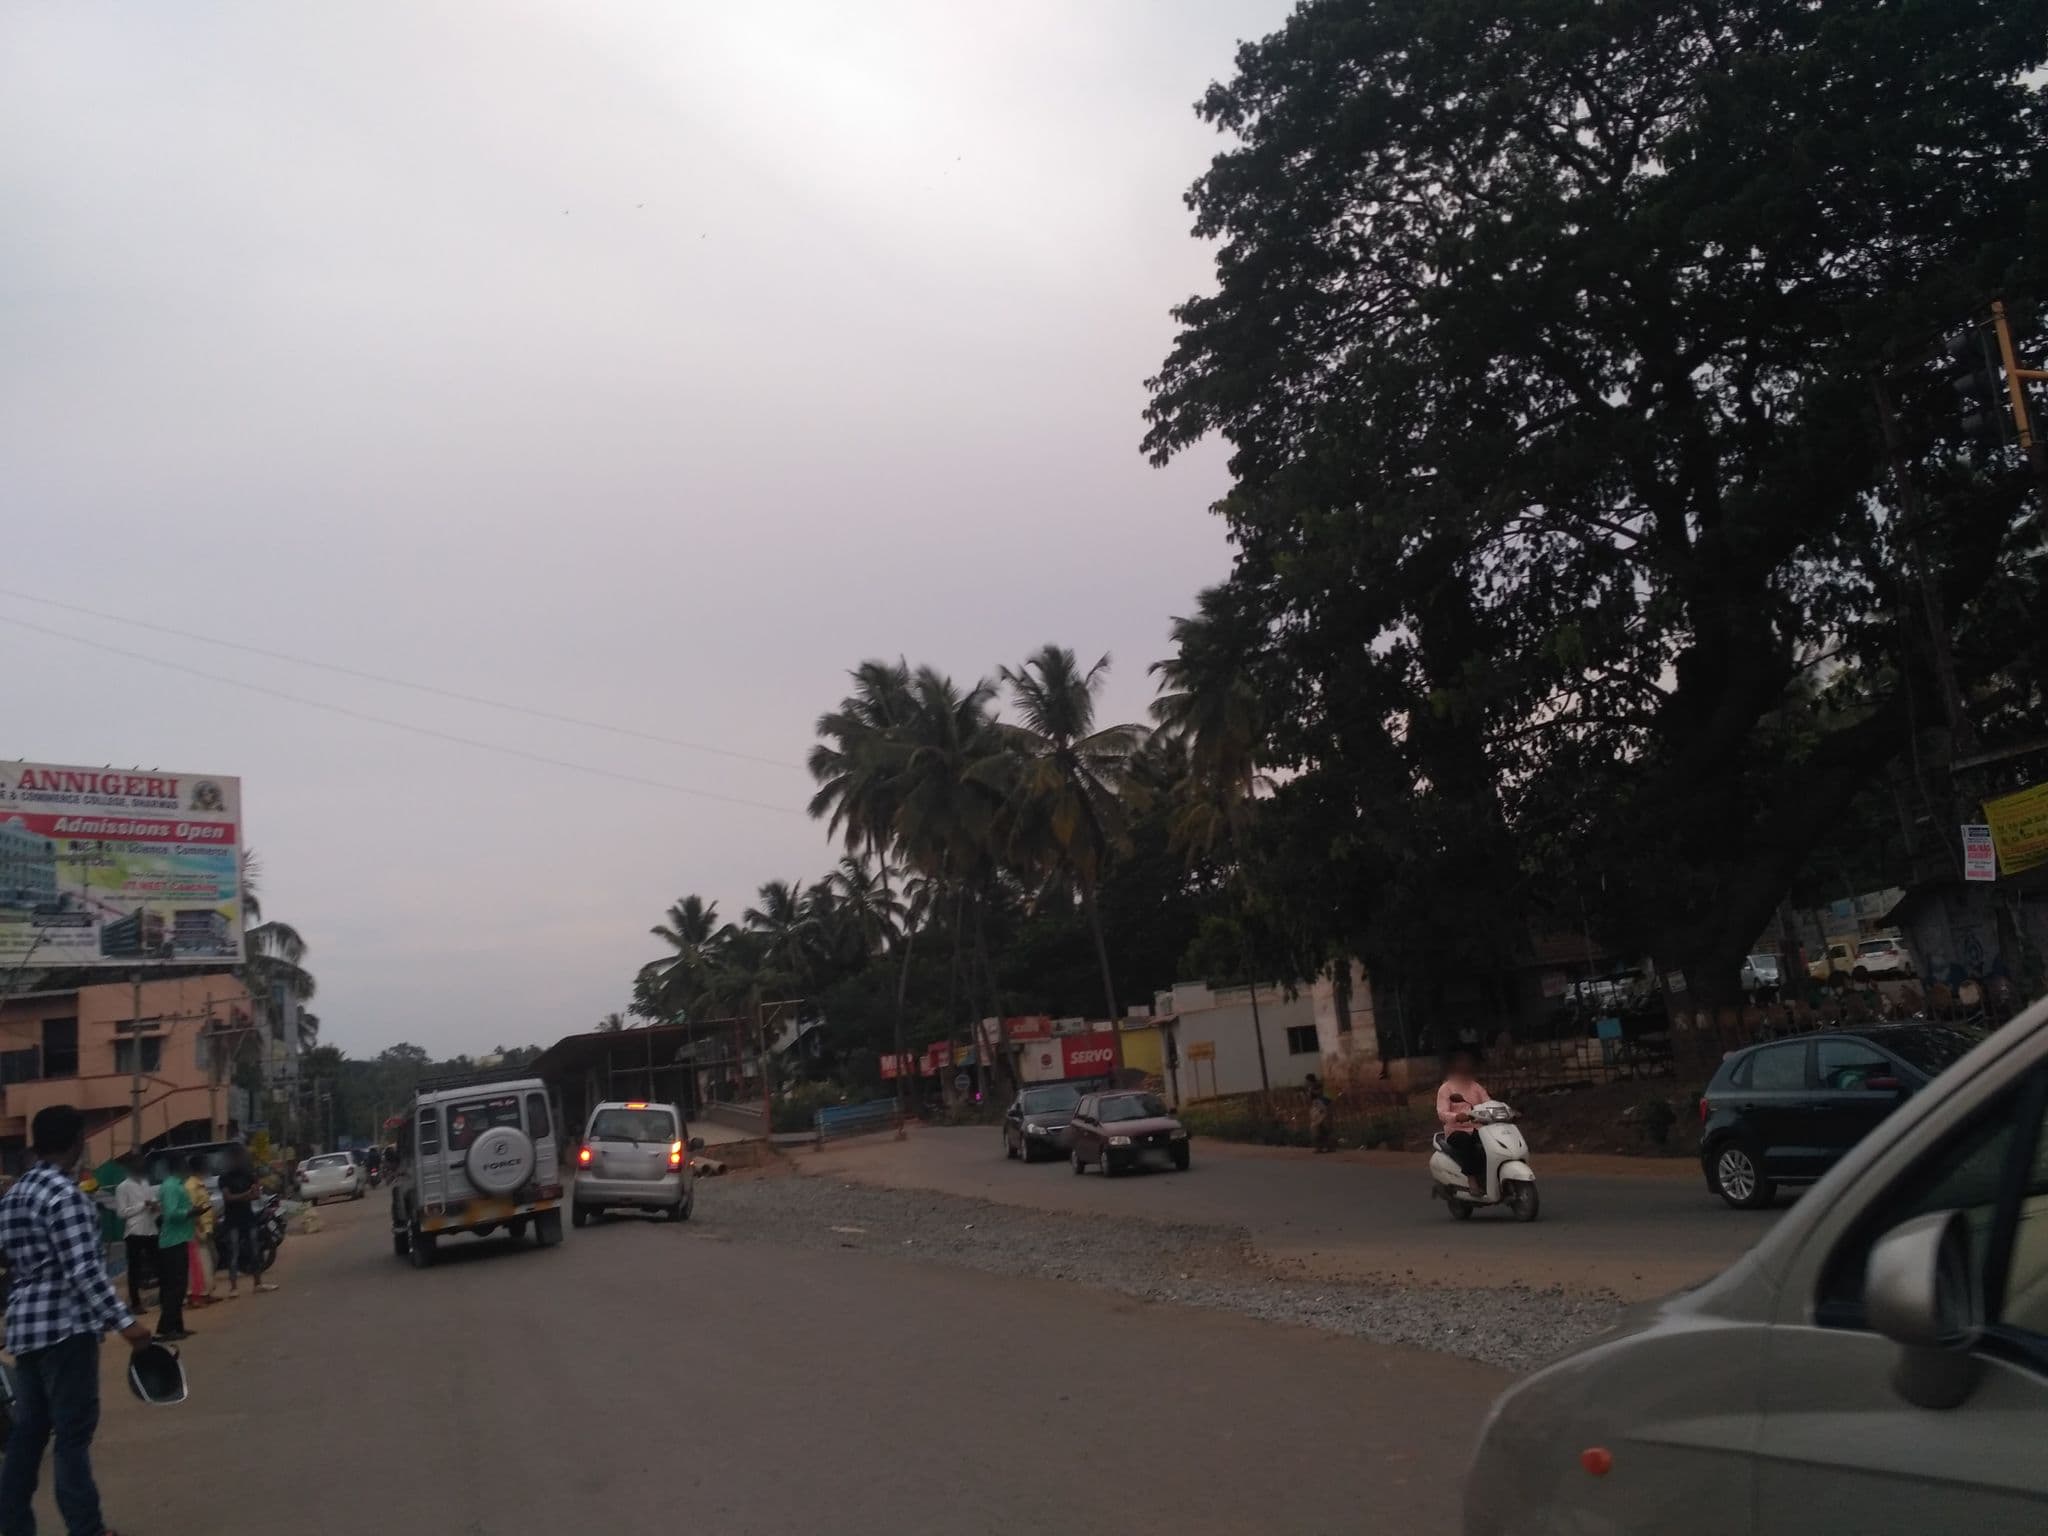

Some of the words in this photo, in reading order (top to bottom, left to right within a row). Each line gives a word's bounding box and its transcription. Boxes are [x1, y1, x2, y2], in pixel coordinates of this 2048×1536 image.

[18, 769, 180, 798] ANNIGERI
[53, 816, 170, 837] Admissions
[175, 823, 225, 840] Open
[1069, 1049, 1113, 1065] SERVO
[482, 1158, 522, 1171] FORCE
